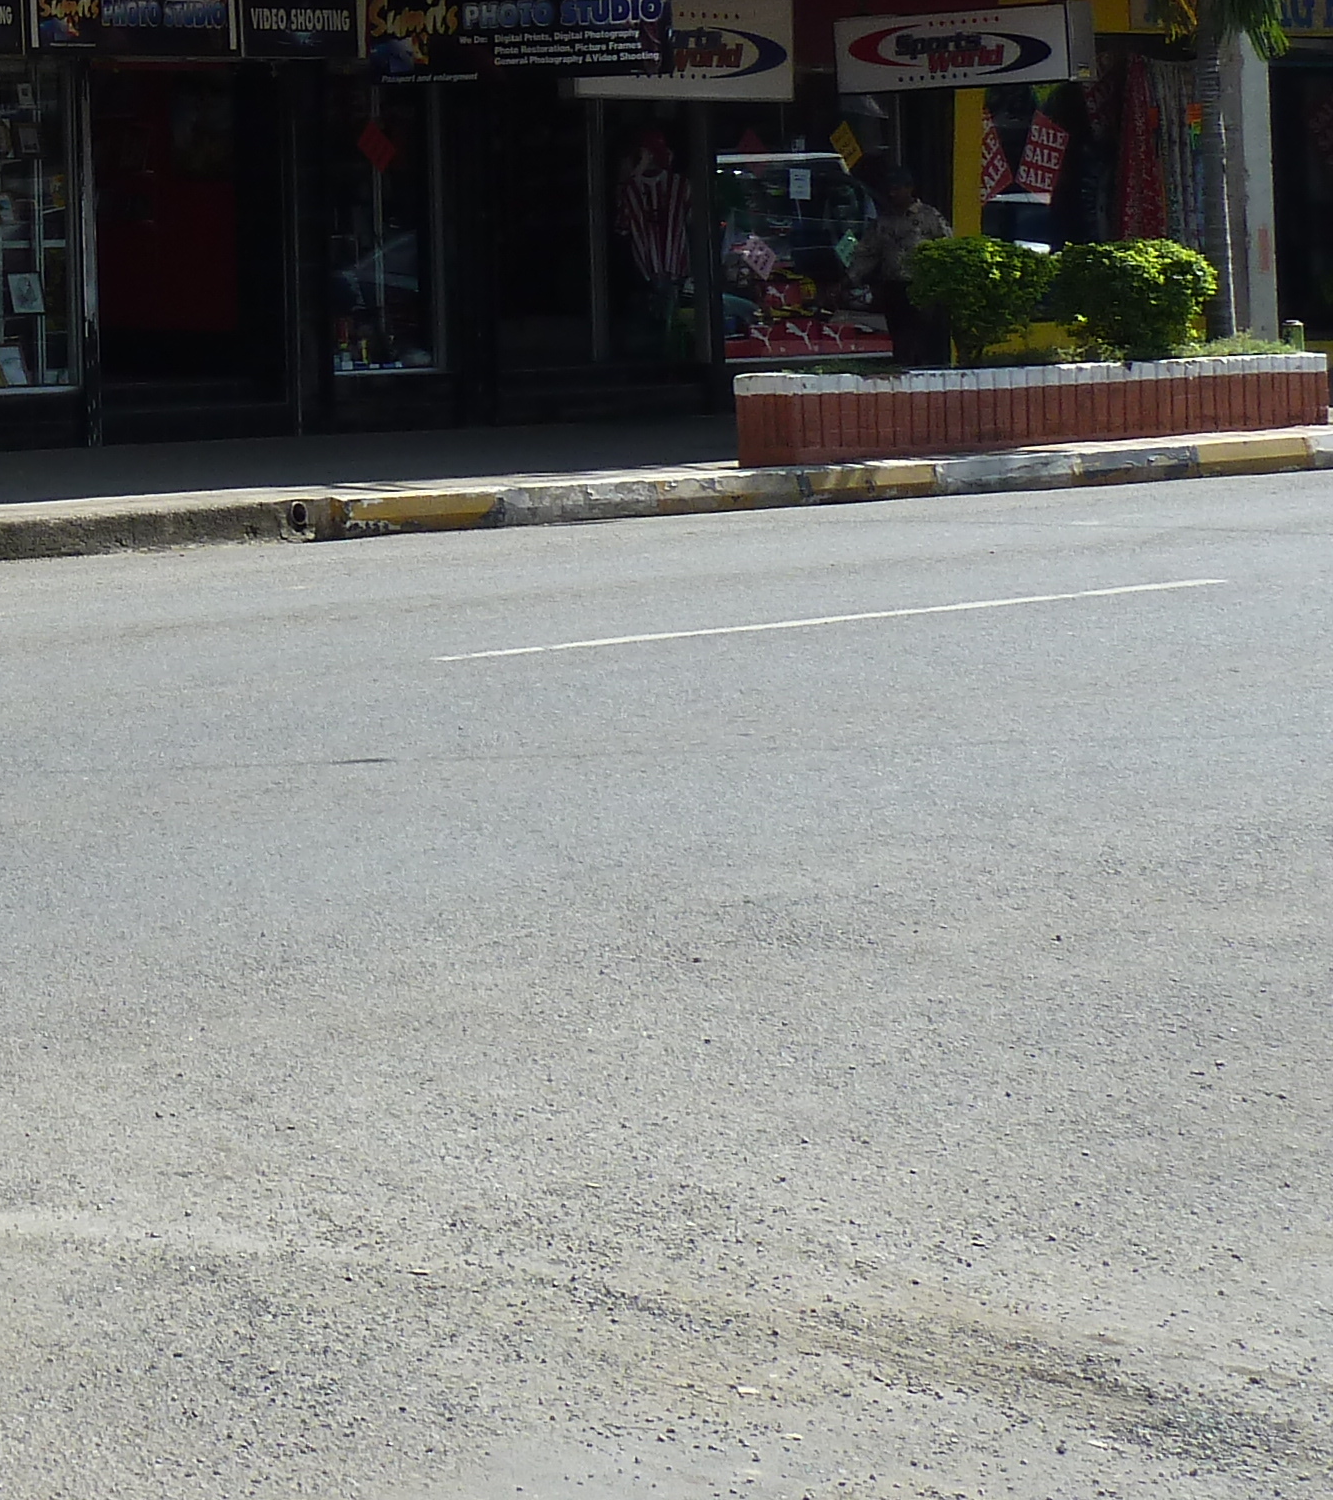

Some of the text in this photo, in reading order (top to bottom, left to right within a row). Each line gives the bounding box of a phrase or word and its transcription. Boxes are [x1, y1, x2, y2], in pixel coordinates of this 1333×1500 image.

[250, 7, 351, 32] VIDEO SHOOTING
[462, 0, 556, 31] PHOTO
[493, 45, 519, 56] Photo
[574, 42, 607, 52] Picture
[608, 41, 642, 51] Frames
[494, 33, 523, 44] Digital
[553, 30, 583, 42] Digital
[583, 28, 640, 40] Photography
[895, 32, 982, 60] Sports
[493, 57, 529, 67] General
[529, 55, 583, 67] Photography
[592, 53, 618, 62] Video
[619, 51, 660, 62] Shooting
[927, 44, 1005, 74] World
[1030, 124, 1066, 151] SALE
[1024, 144, 1061, 171] SALE
[1018, 165, 1054, 192] SALE
